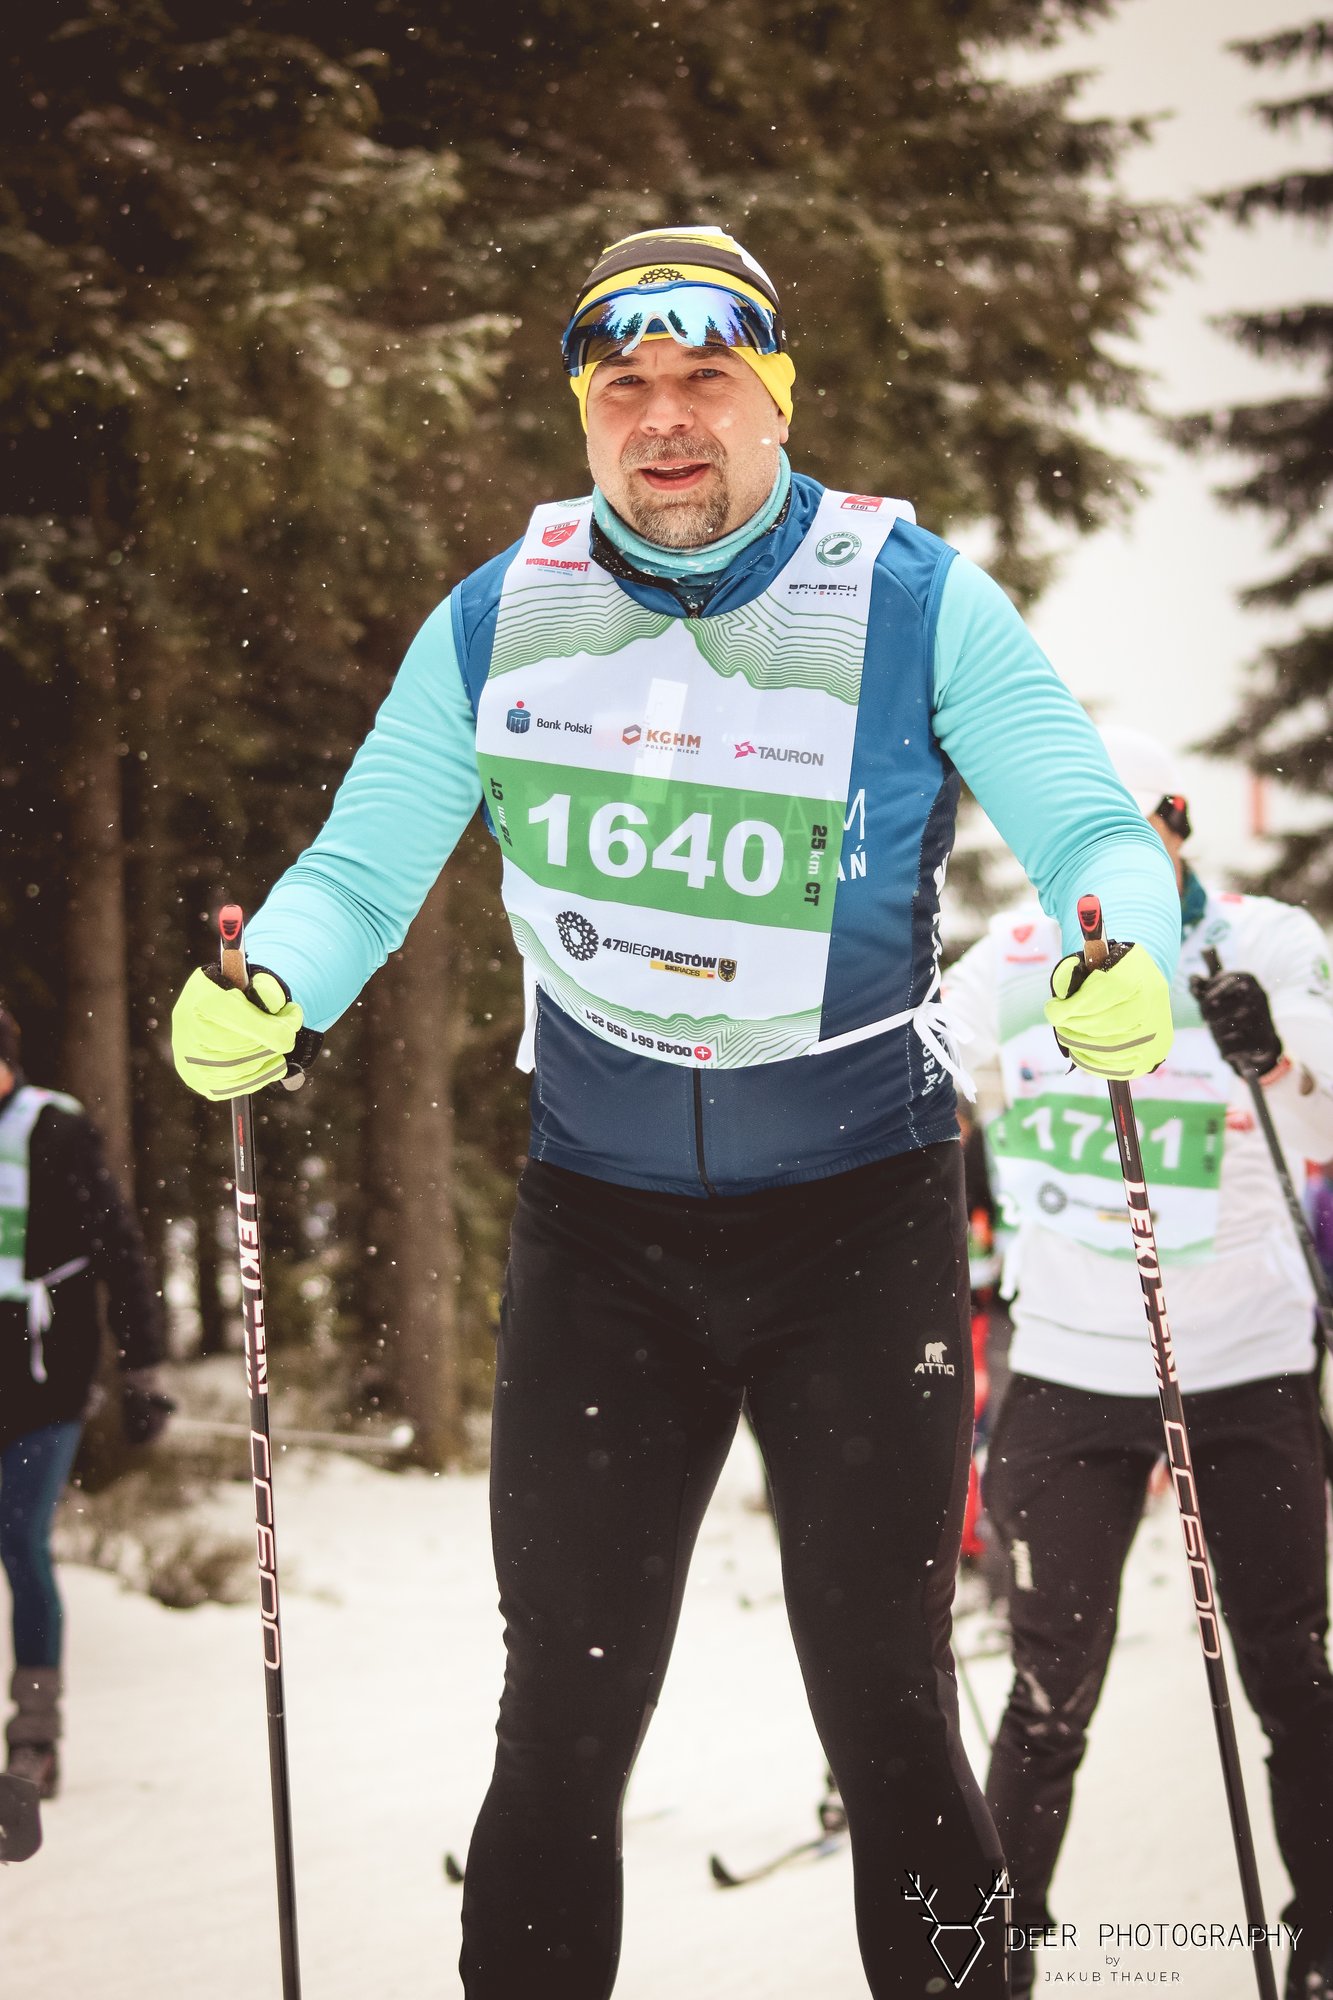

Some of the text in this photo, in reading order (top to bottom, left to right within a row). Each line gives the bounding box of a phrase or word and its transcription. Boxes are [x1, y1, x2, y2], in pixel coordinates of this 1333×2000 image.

[525, 557, 591, 572] WORLDLOPPET
[536, 717, 593, 735] Bank Polski
[646, 729, 702, 749] KGHM
[758, 745, 824, 767] TAURON
[528, 792, 784, 898] 1640
[803, 824, 828, 907] 25km CT
[585, 1009, 692, 1057] 0048 661 959 221
[236, 1186, 261, 1291] LEKI
[1124, 1176, 1161, 1280] LEKI
[914, 1362, 955, 1377] ATTIQ
